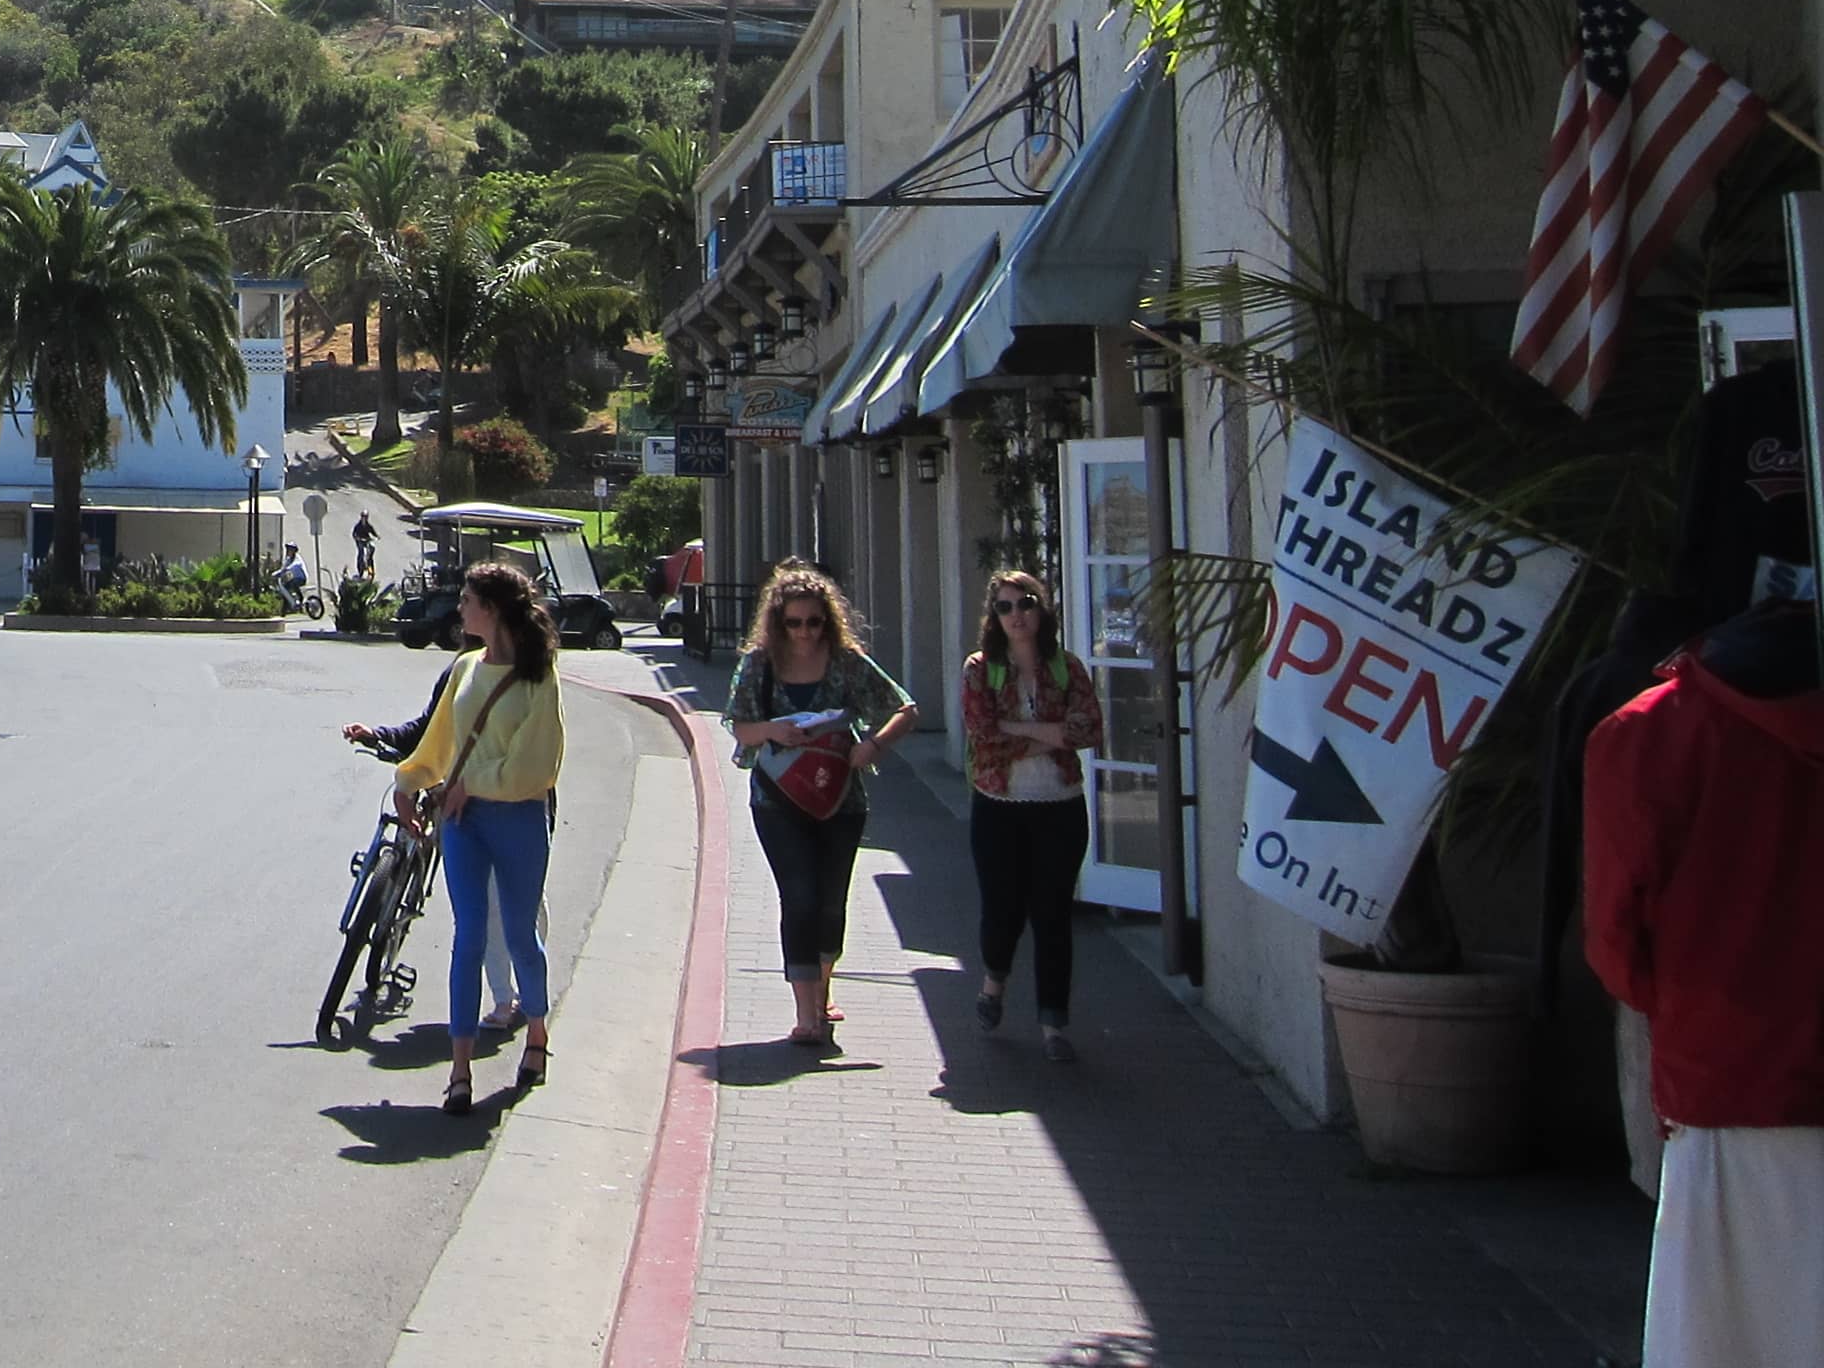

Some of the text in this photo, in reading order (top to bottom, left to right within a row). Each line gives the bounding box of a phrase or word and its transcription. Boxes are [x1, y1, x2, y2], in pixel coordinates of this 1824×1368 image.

[1275, 494, 1527, 666] THREADZ
[1302, 448, 1518, 589] ISLAND
[1262, 585, 1489, 773] PEN
[1255, 831, 1310, 888] On
[1318, 866, 1360, 916] In
